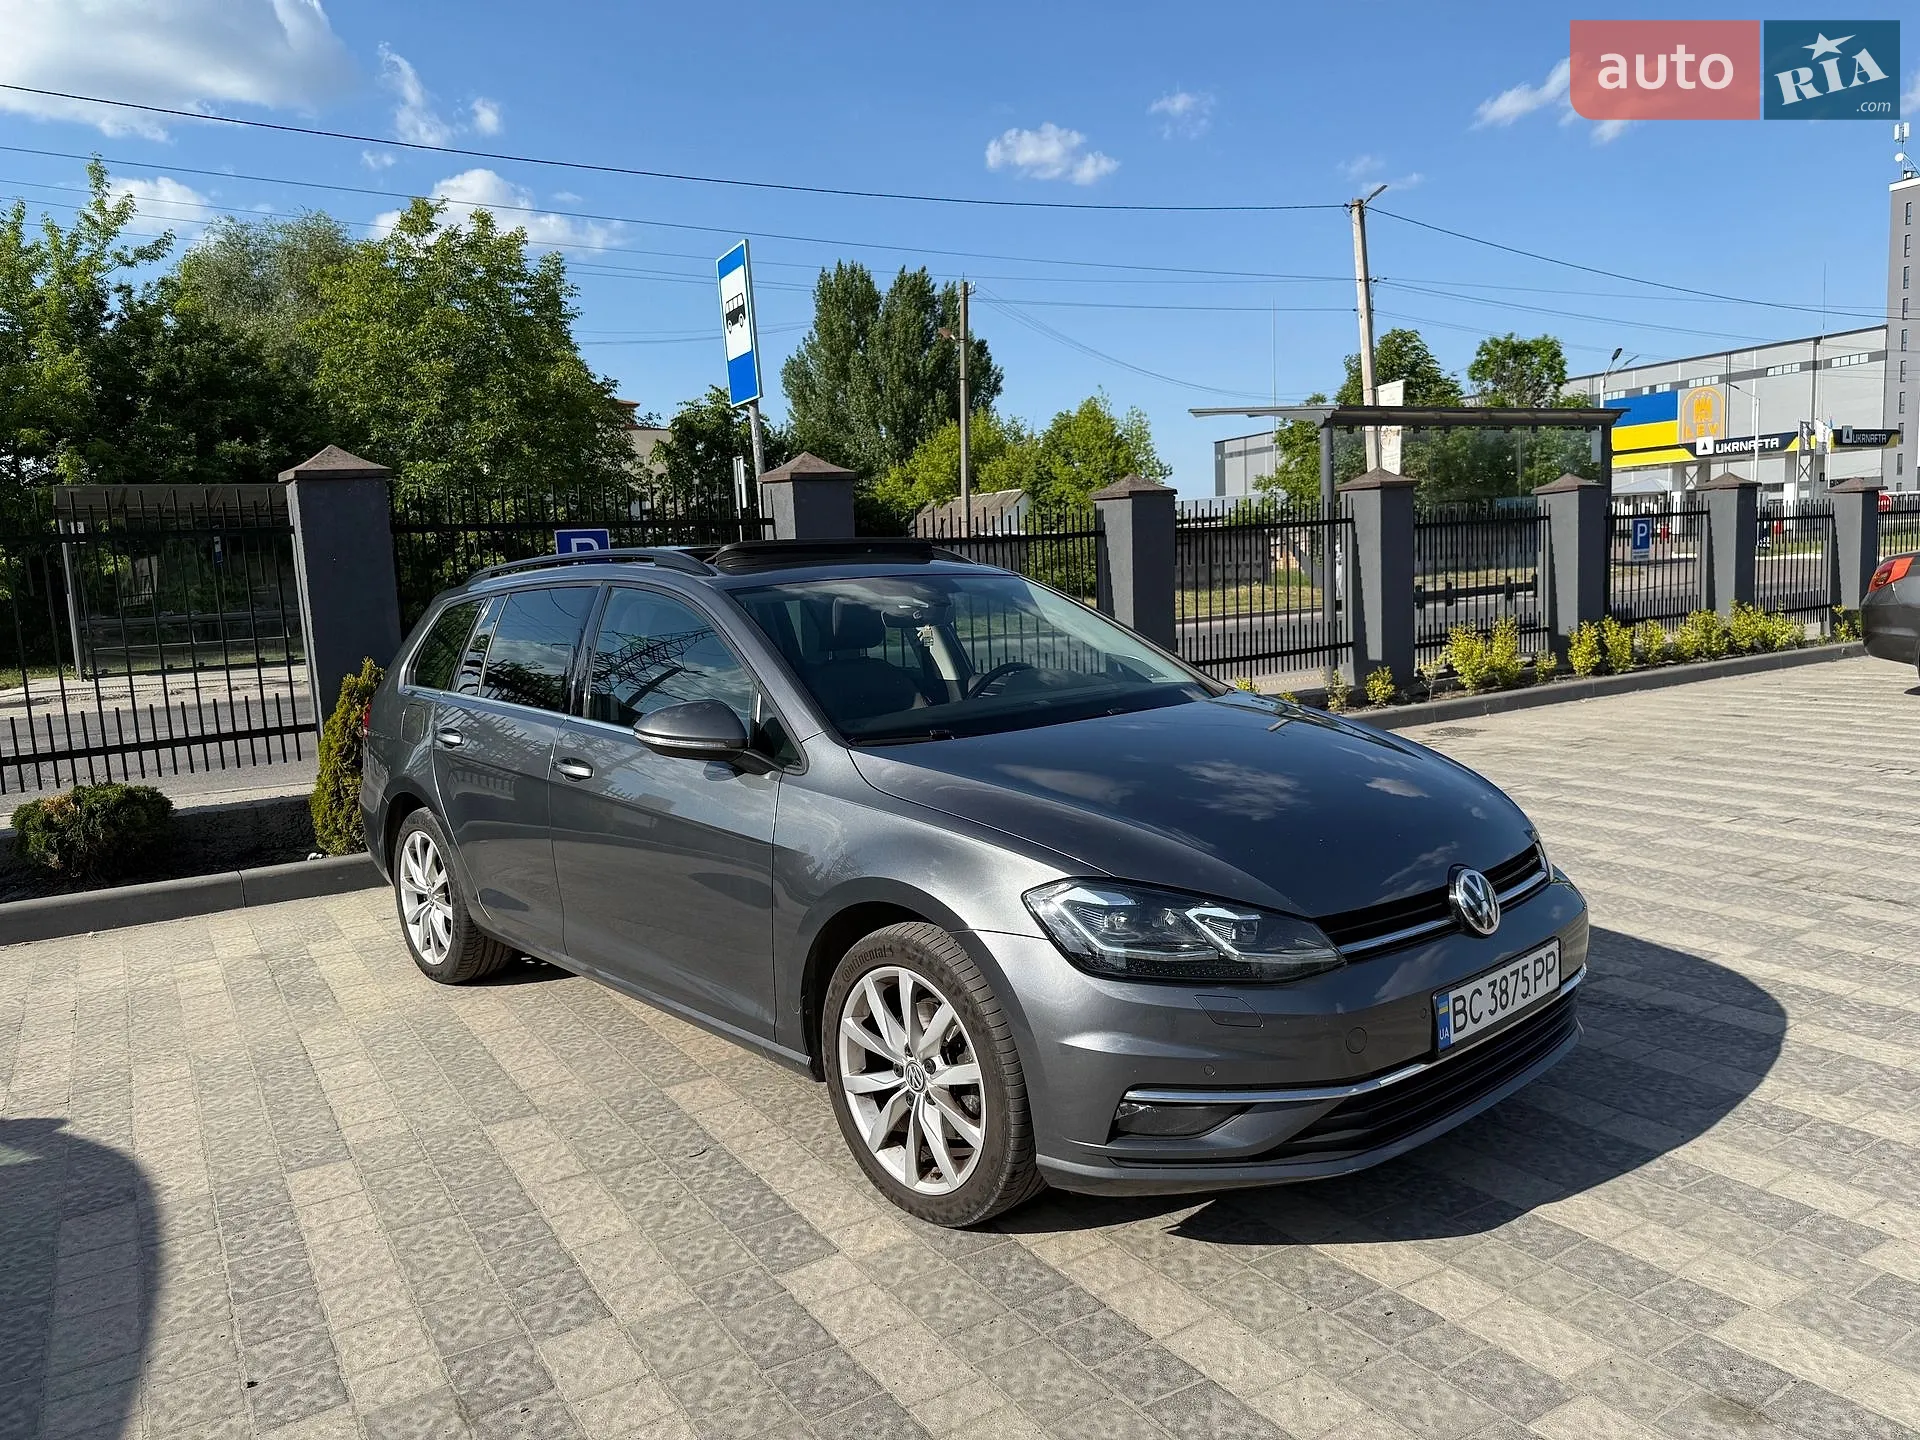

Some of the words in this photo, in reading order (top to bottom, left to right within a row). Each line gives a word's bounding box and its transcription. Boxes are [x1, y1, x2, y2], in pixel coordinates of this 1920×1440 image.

[1852, 432, 1887, 444] UKRNAFTA
[1636, 523, 1648, 546] P
[1452, 988, 1483, 1034] BC
[1487, 963, 1530, 1016] 3875
[1533, 951, 1556, 994] PP
[1439, 1026, 1450, 1040] UA
